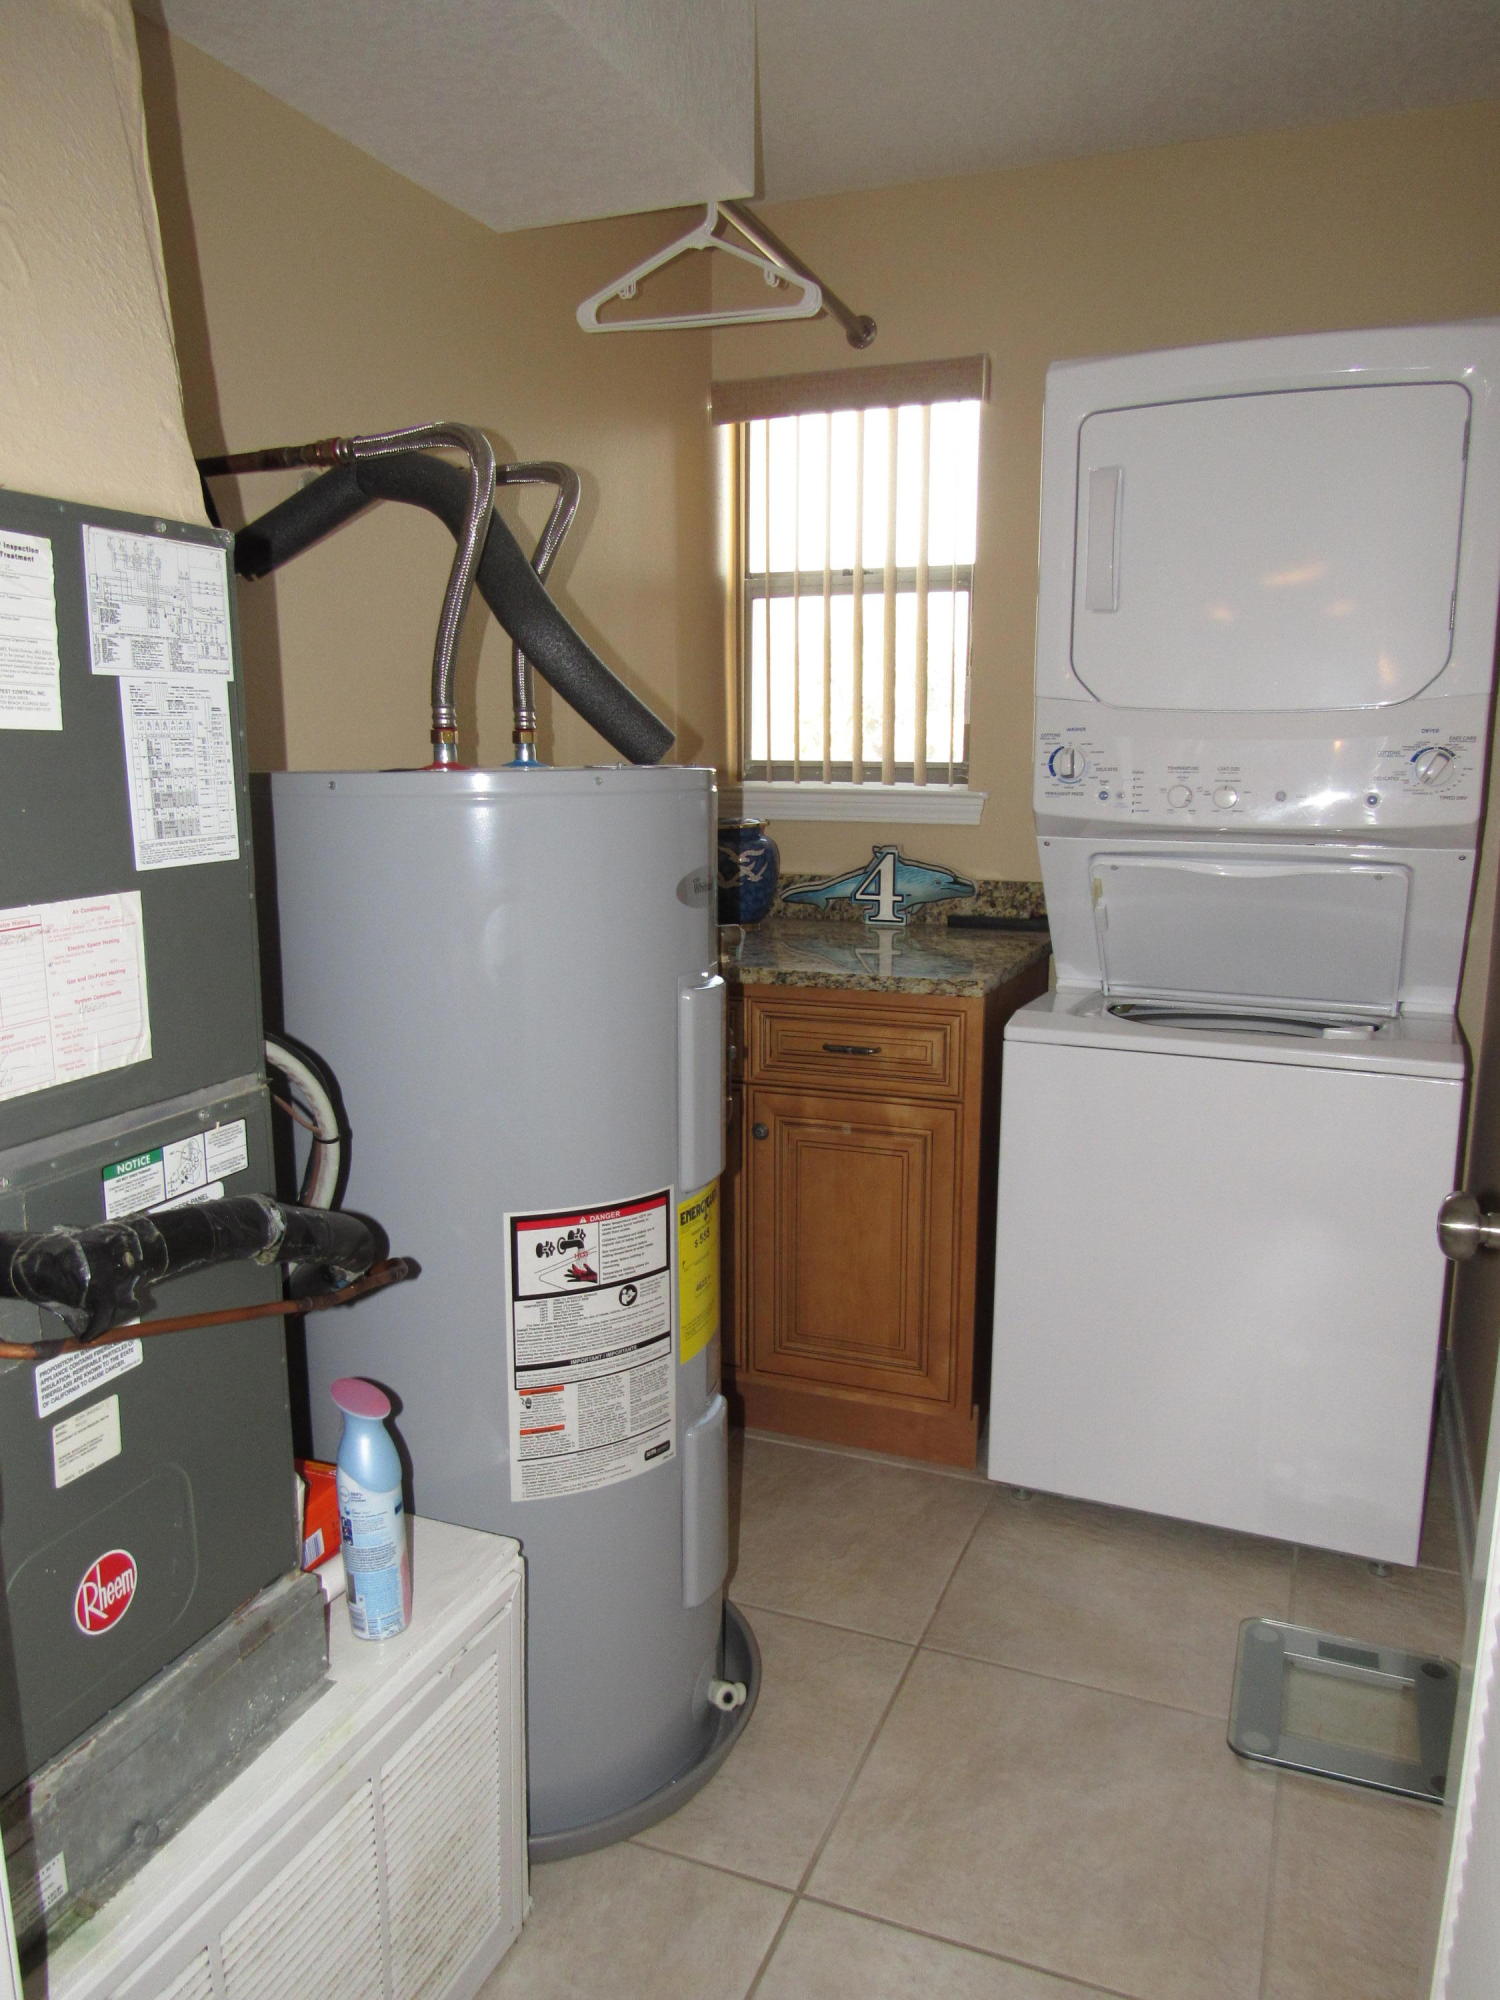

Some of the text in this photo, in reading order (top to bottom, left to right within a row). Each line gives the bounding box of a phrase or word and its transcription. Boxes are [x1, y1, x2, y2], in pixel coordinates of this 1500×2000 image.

[4, 541, 39, 553] Inspection
[0, 550, 34, 562] Treatment
[854, 852, 904, 923] 4
[116, 1154, 151, 1175] NOTICE
[590, 1210, 620, 1222] DANGER
[570, 1354, 602, 1365] IMPORTANT
[50, 1385, 80, 1404] CALIFORNIA
[82, 1563, 134, 1630] Rheem
